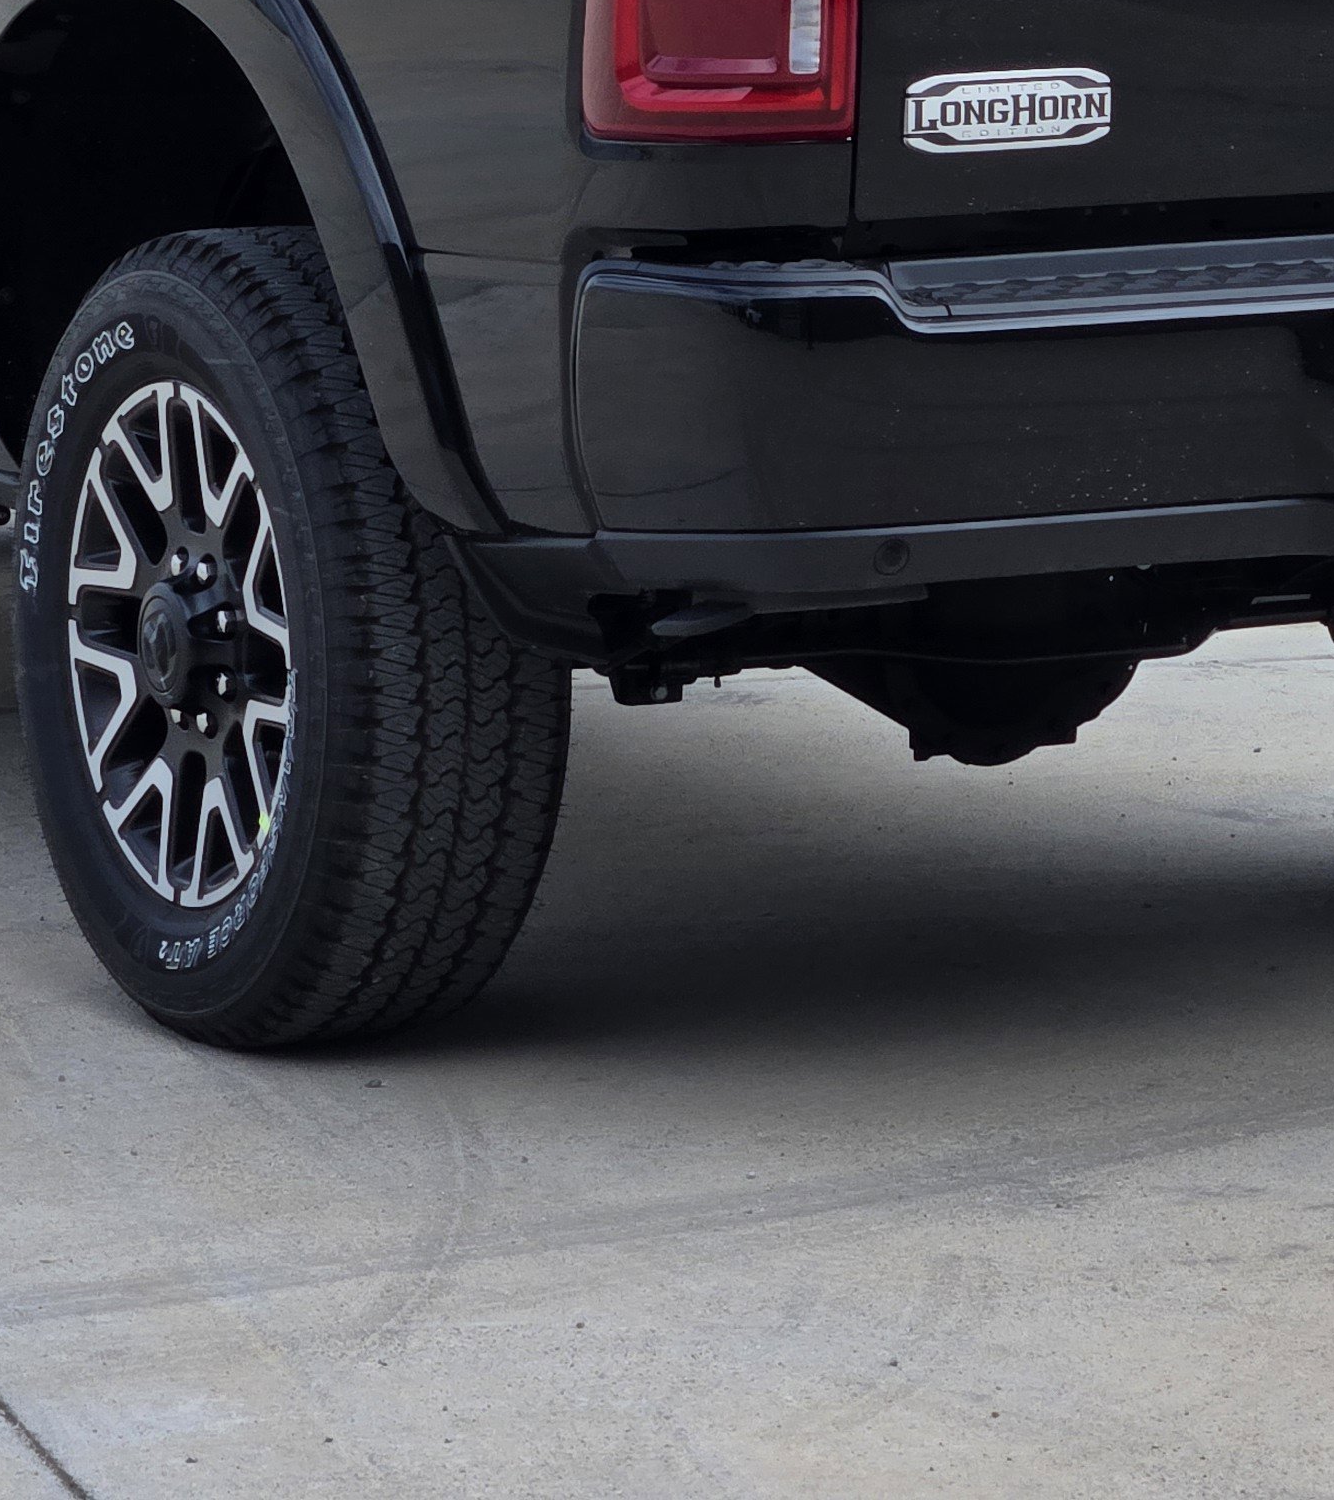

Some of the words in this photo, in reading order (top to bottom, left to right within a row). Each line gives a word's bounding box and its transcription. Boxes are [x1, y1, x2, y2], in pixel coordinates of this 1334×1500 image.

[962, 82, 1061, 95] LIMITED
[962, 125, 1061, 138] EDITION
[19, 320, 135, 592] Firestone
